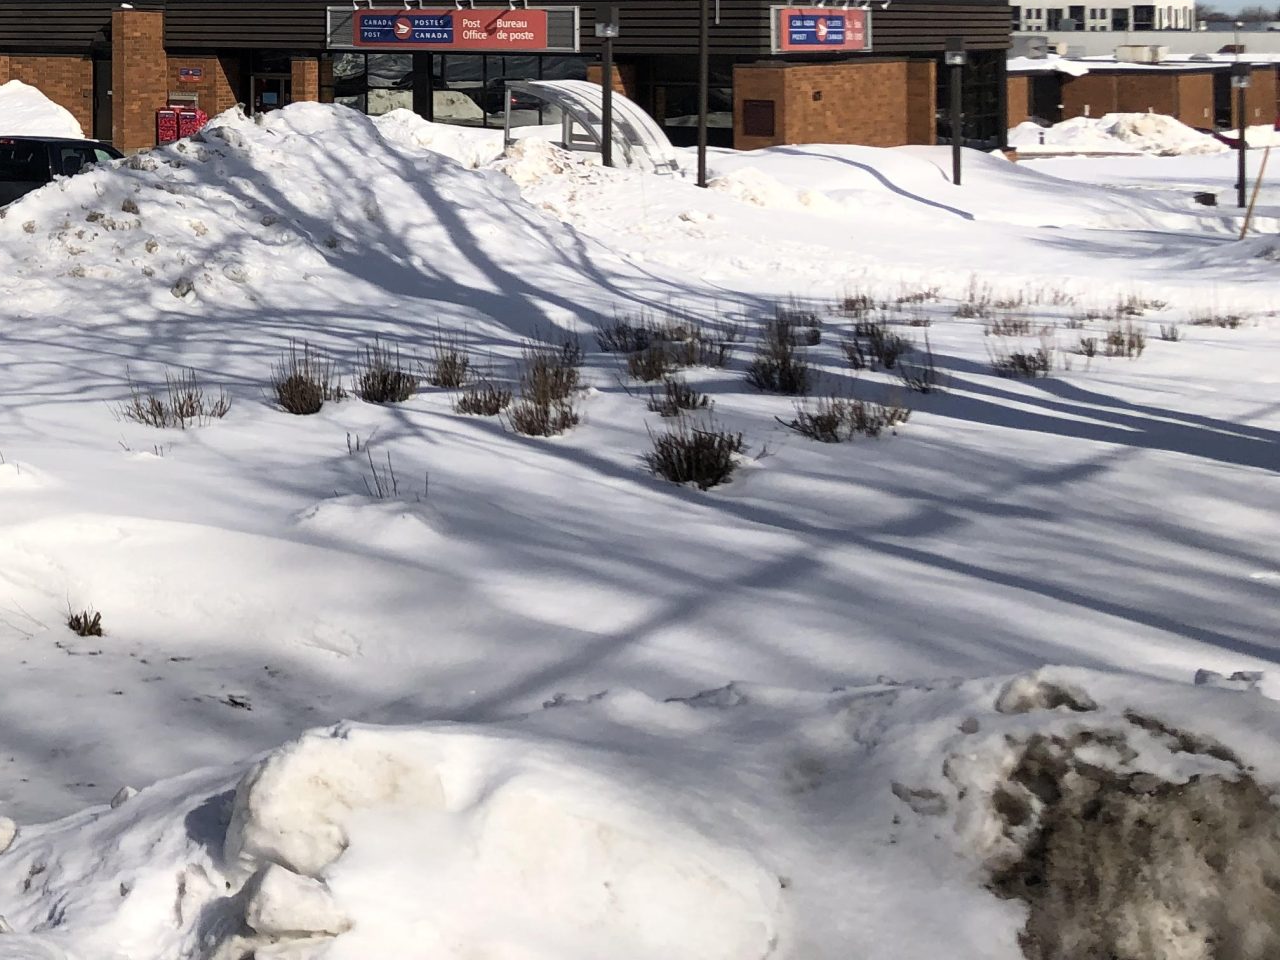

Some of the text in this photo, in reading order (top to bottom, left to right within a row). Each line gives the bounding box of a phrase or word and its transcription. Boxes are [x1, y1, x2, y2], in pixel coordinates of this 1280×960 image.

[462, 18, 480, 28] Post
[496, 18, 527, 28] Bureau
[462, 30, 487, 40] Office
[496, 30, 534, 41] de poste
